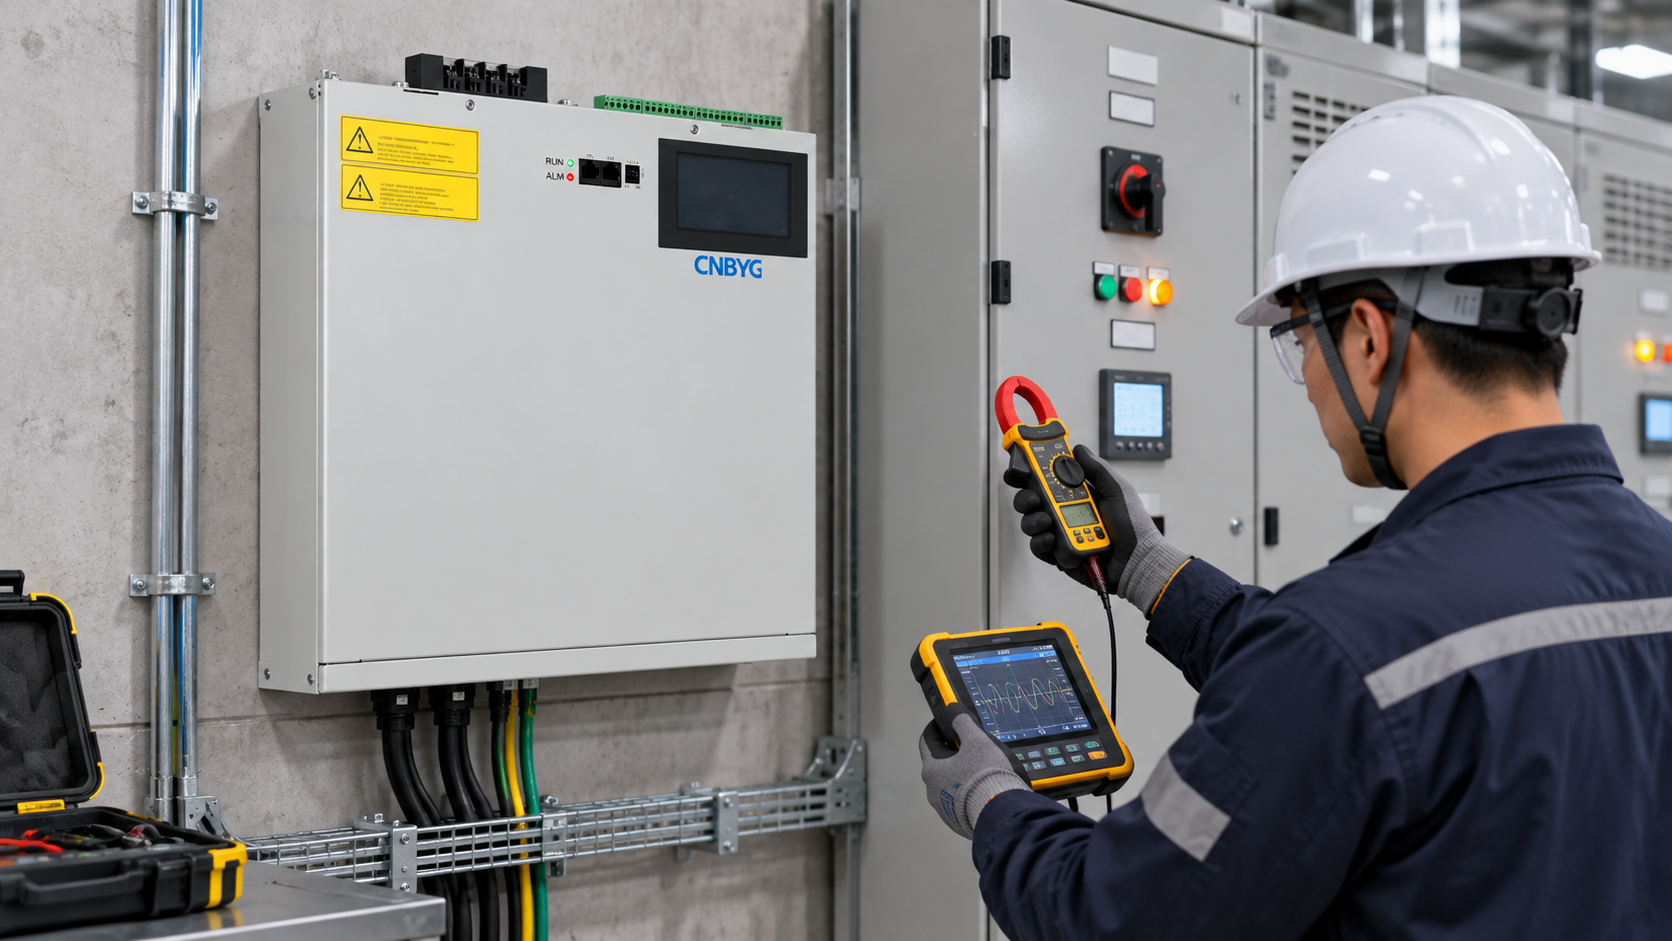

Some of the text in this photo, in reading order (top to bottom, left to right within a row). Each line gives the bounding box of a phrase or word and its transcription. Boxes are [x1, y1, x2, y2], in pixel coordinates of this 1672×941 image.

[545, 157, 564, 166] RUN
[545, 172, 565, 181] ALM
[694, 255, 762, 278] CNBYG
